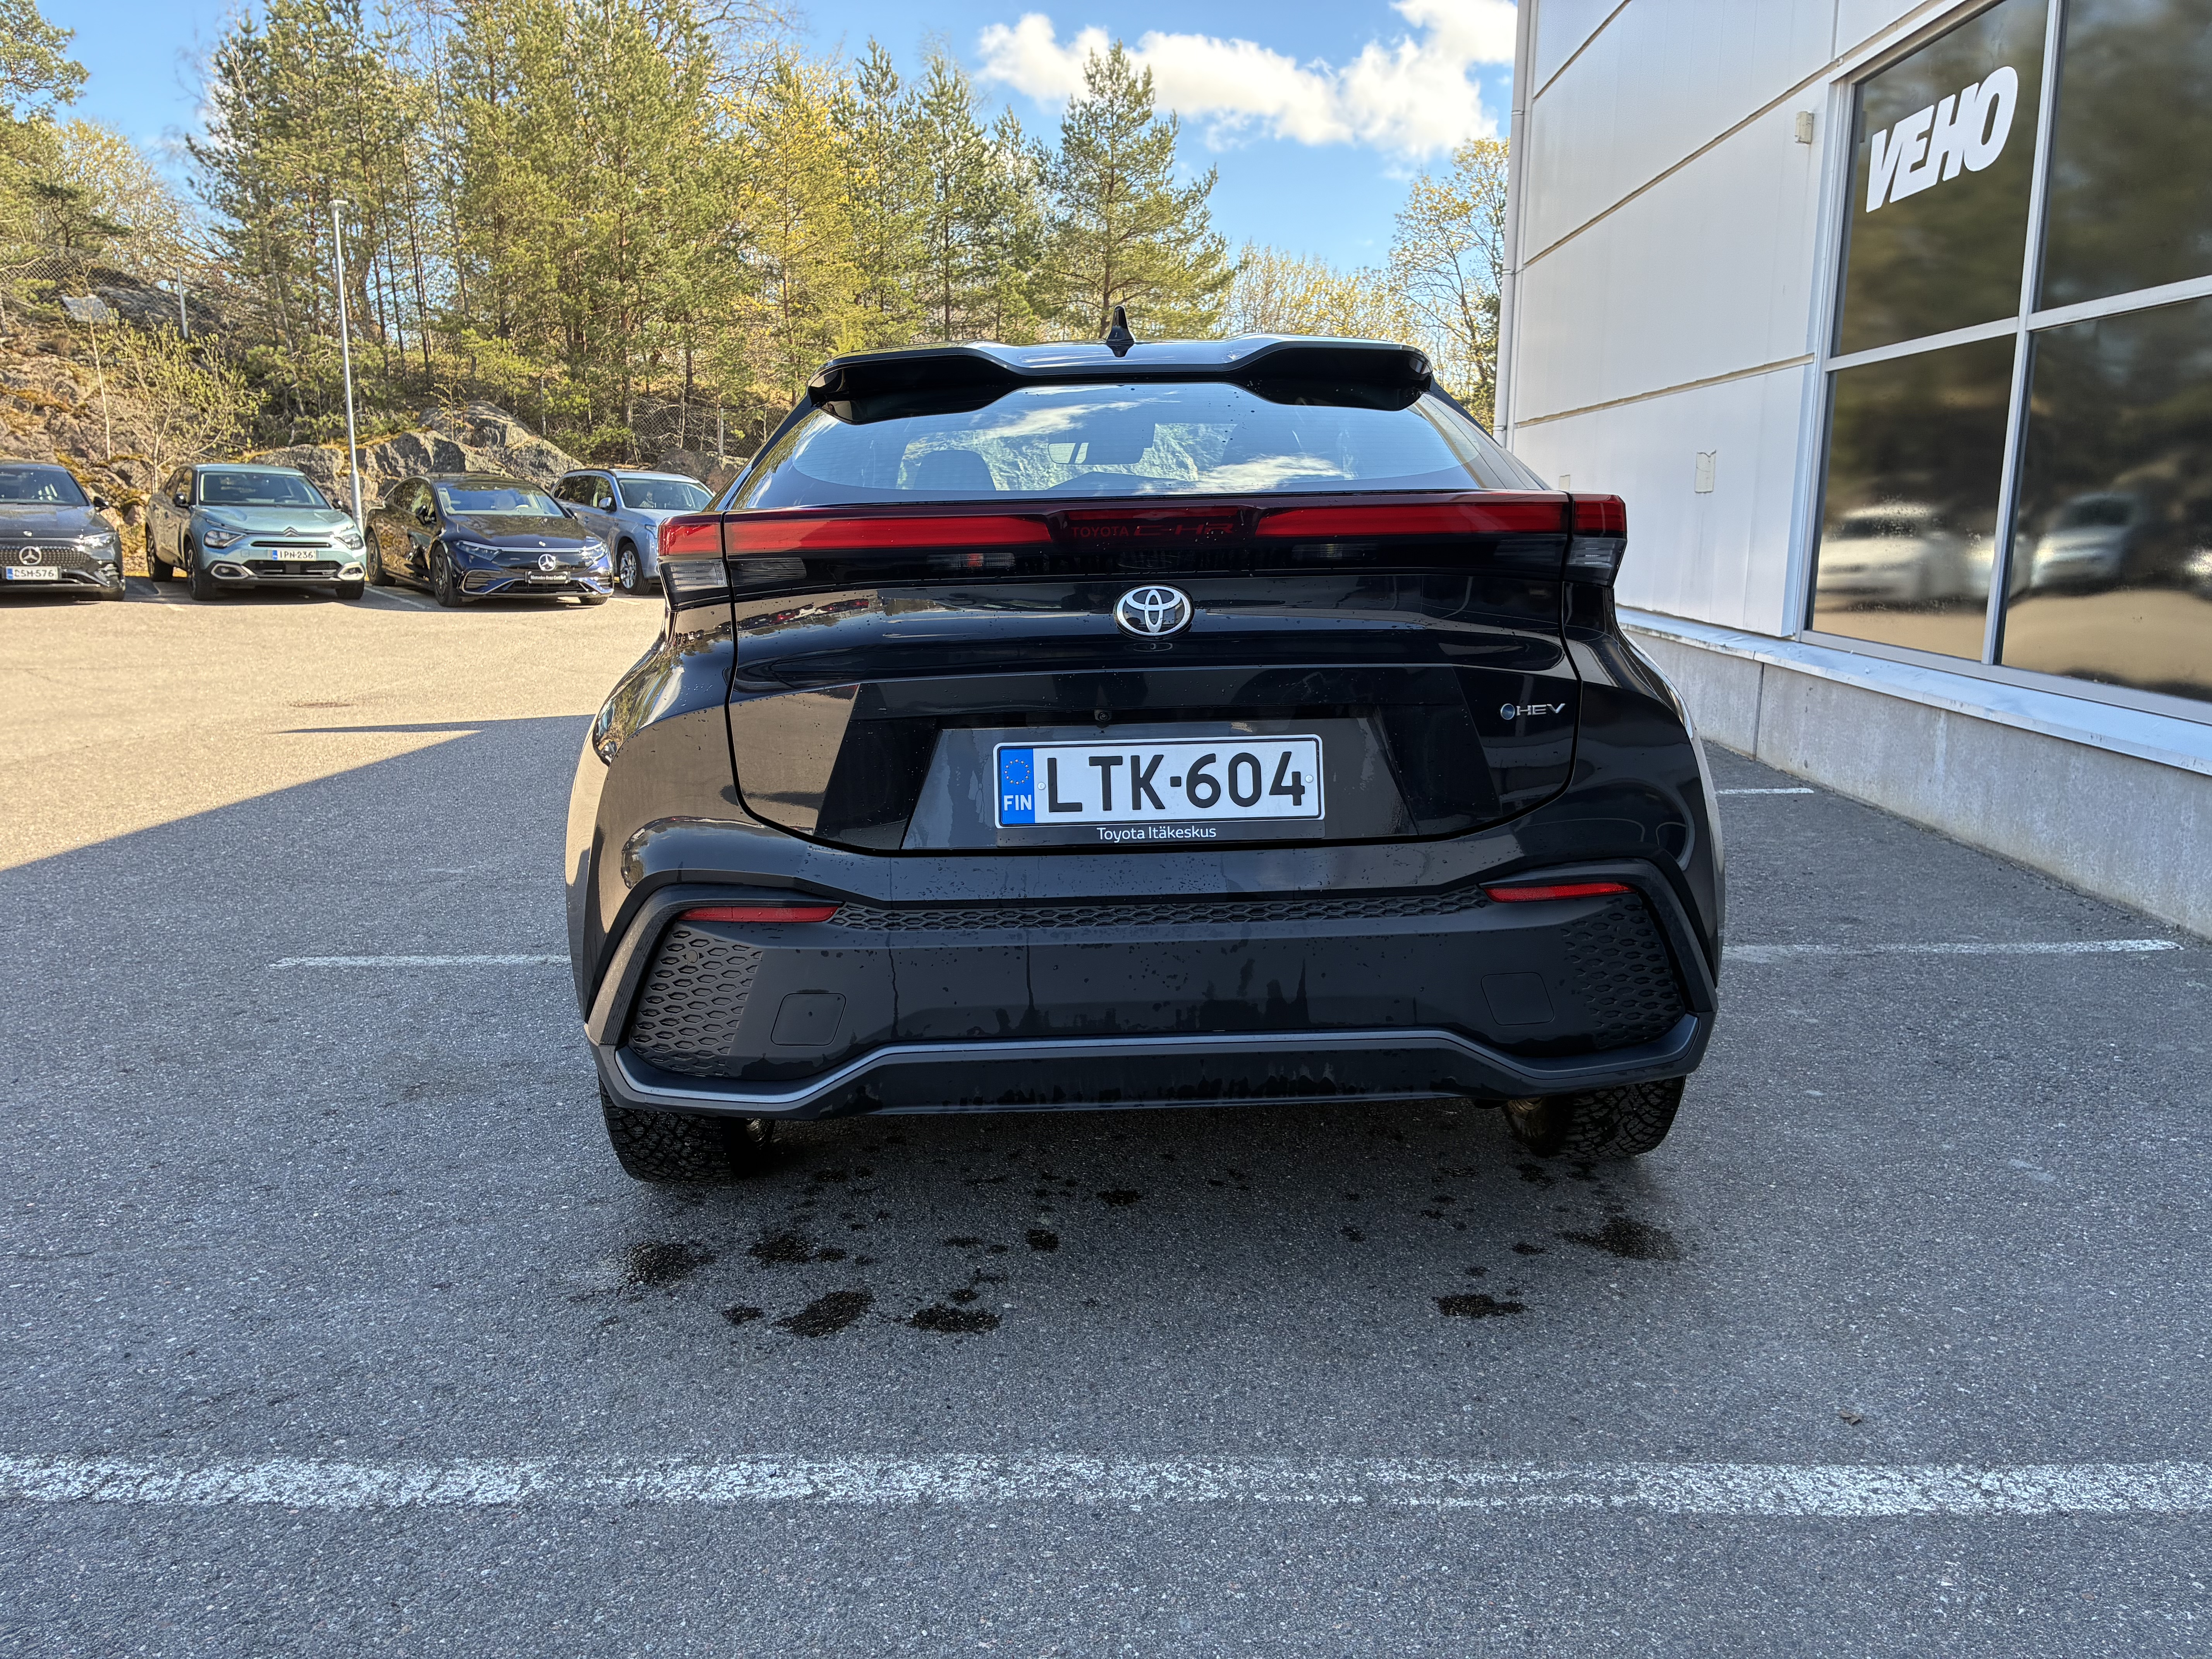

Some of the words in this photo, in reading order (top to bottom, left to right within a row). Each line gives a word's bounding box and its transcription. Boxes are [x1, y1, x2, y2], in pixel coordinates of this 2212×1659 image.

[1866, 66, 2018, 213] VEHO
[1071, 526, 1129, 538] TOYOTA
[1133, 523, 1234, 536] C-HR
[280, 550, 313, 558] IPN-236
[1516, 703, 1566, 716] HEV
[1047, 751, 1305, 813] LTK-604
[1003, 794, 1032, 811] FIN
[1096, 827, 1145, 843] Toyota
[1148, 826, 1216, 839] Itäkeskus
